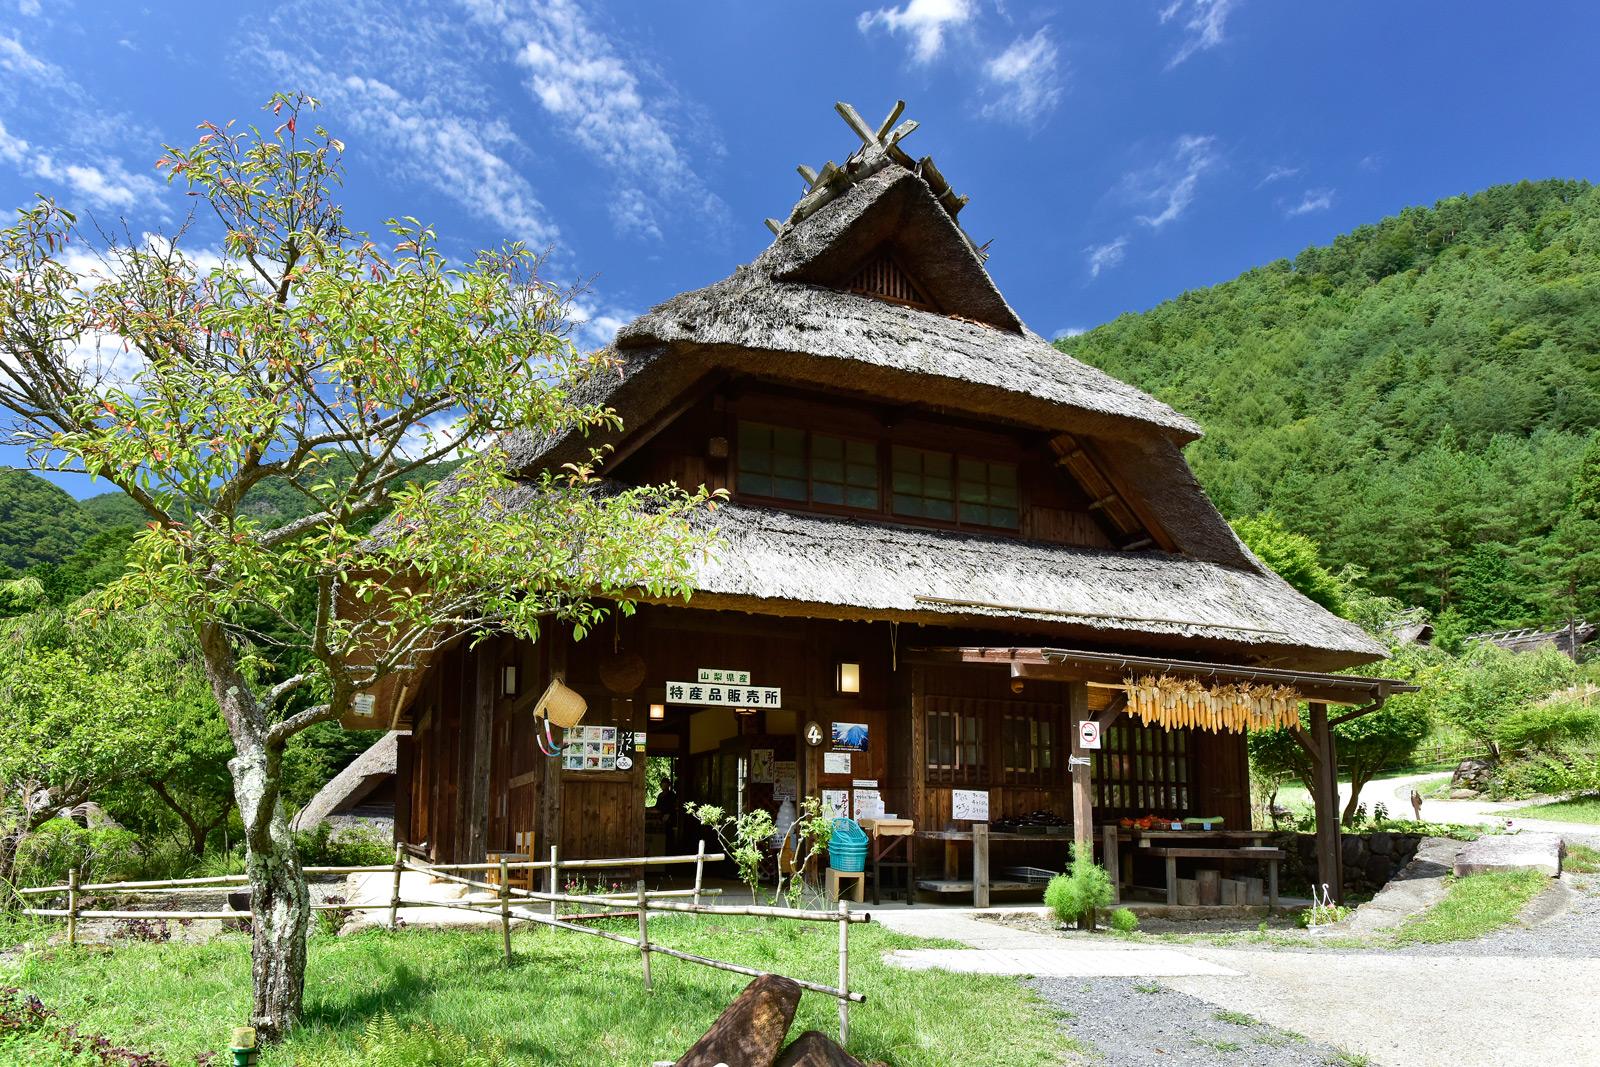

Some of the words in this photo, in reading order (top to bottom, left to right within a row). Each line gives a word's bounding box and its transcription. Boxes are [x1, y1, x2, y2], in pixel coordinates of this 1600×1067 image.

[700, 671, 748, 683] 山梨県産
[669, 685, 778, 704] 特産品販売所
[625, 731, 633, 751] ソフト
[808, 726, 821, 743] 4
